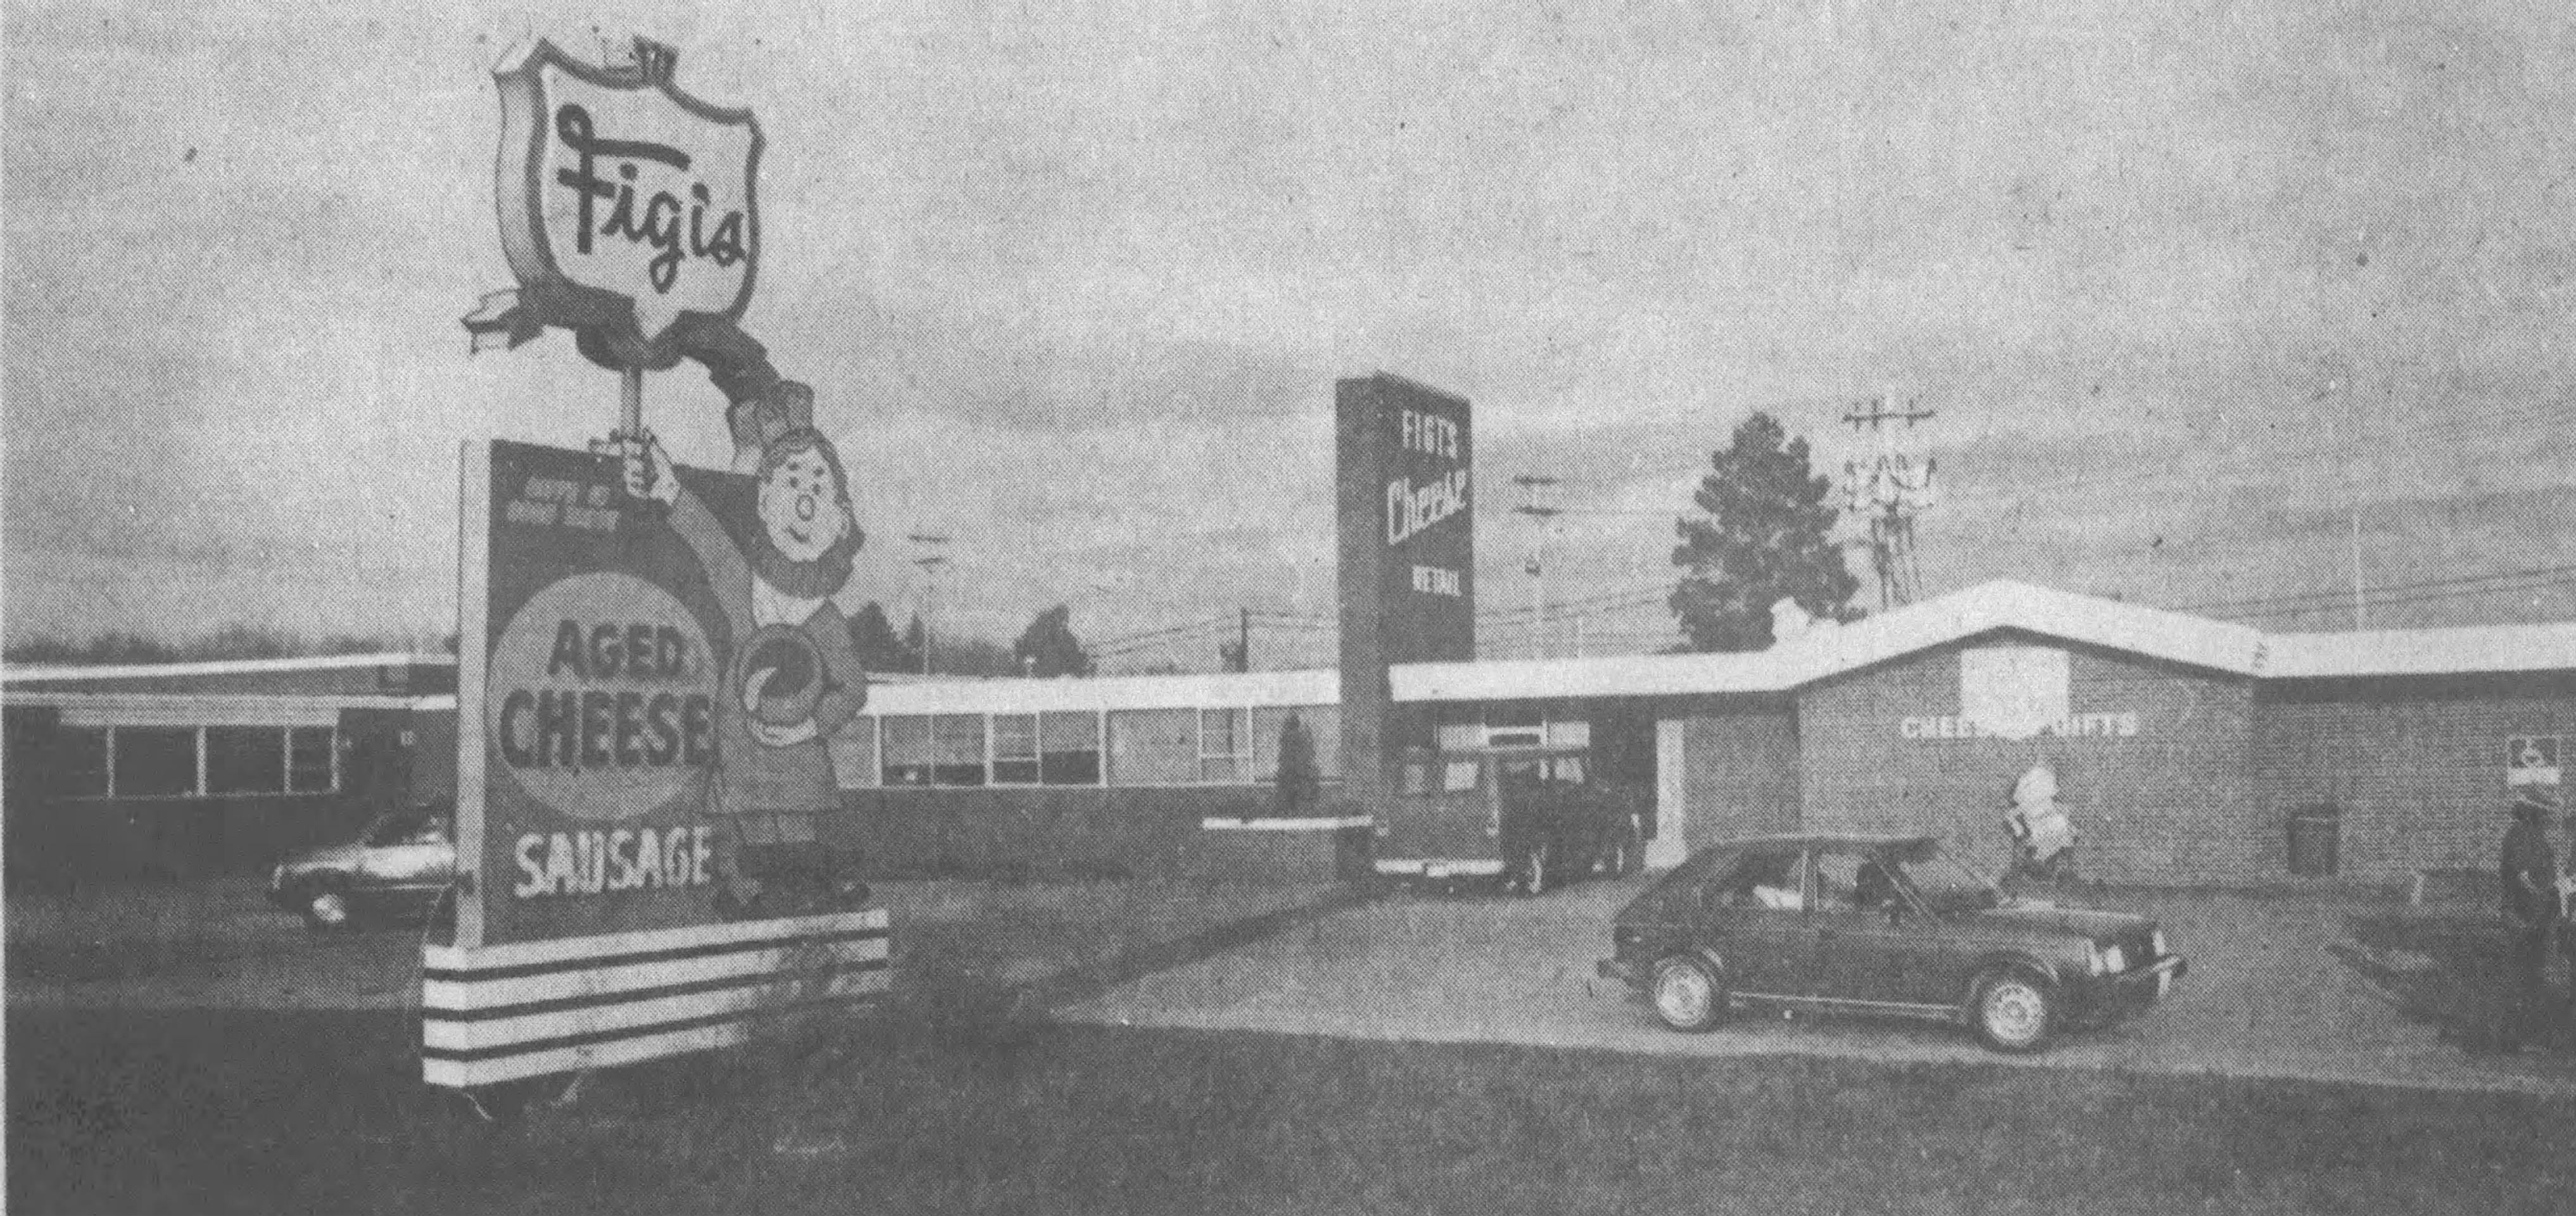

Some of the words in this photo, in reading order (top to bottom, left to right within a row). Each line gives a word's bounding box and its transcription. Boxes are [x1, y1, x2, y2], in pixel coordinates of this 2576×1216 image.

[1387, 470, 1467, 545] Cheese
[548, 620, 685, 677] AGED
[500, 689, 710, 768] CHEESE
[514, 825, 712, 897] SAUSAGE
